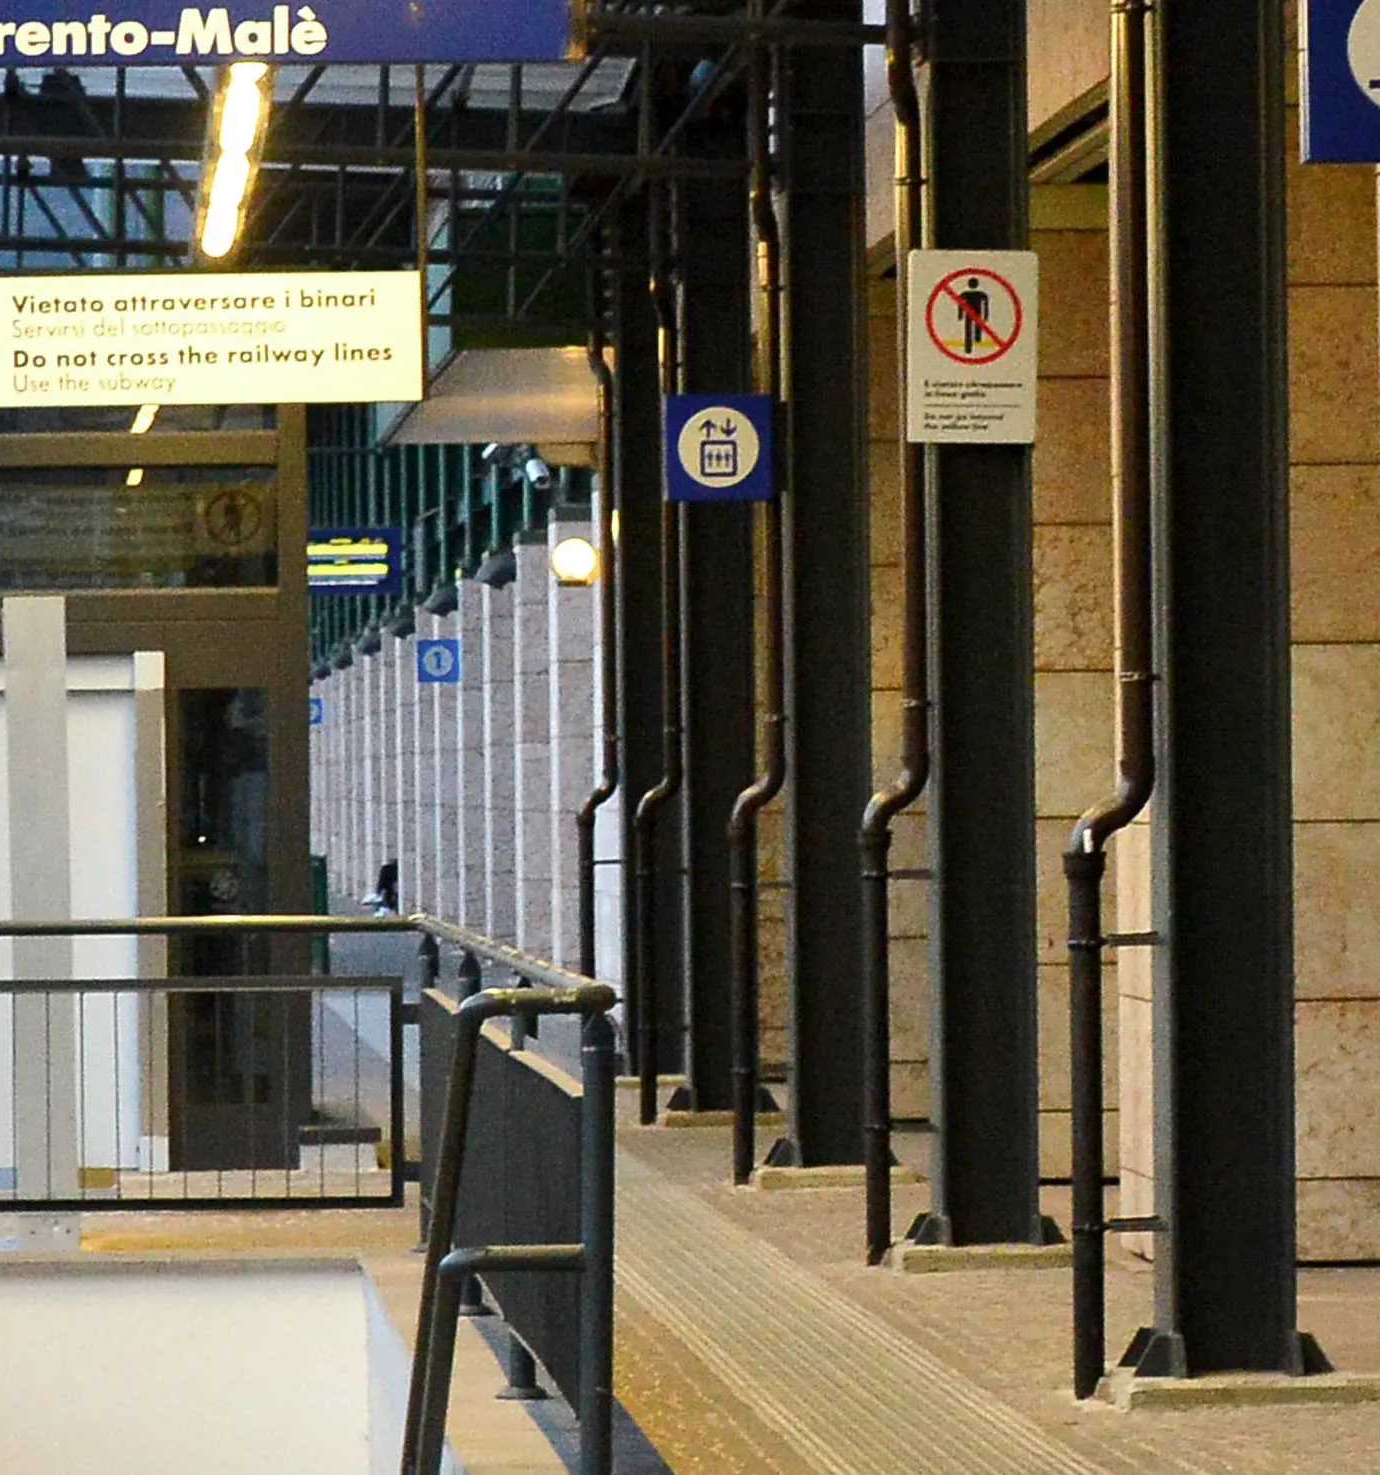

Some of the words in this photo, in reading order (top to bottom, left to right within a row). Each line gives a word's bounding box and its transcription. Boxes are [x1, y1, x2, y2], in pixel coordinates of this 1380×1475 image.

[11, 295, 104, 314] Vietato
[114, 296, 276, 313] attraversare
[284, 290, 291, 308] i
[300, 288, 376, 308] binari
[11, 318, 85, 338] Servirsi
[92, 317, 125, 337] del
[132, 319, 287, 339] sottopassaggio
[13, 350, 47, 368] Do
[56, 351, 97, 367] not
[106, 352, 169, 366] cross
[178, 345, 218, 365] the
[227, 344, 325, 367] railway
[334, 343, 393, 361] lines
[13, 374, 50, 393] Use
[58, 373, 90, 392] the
[98, 372, 176, 392] subway
